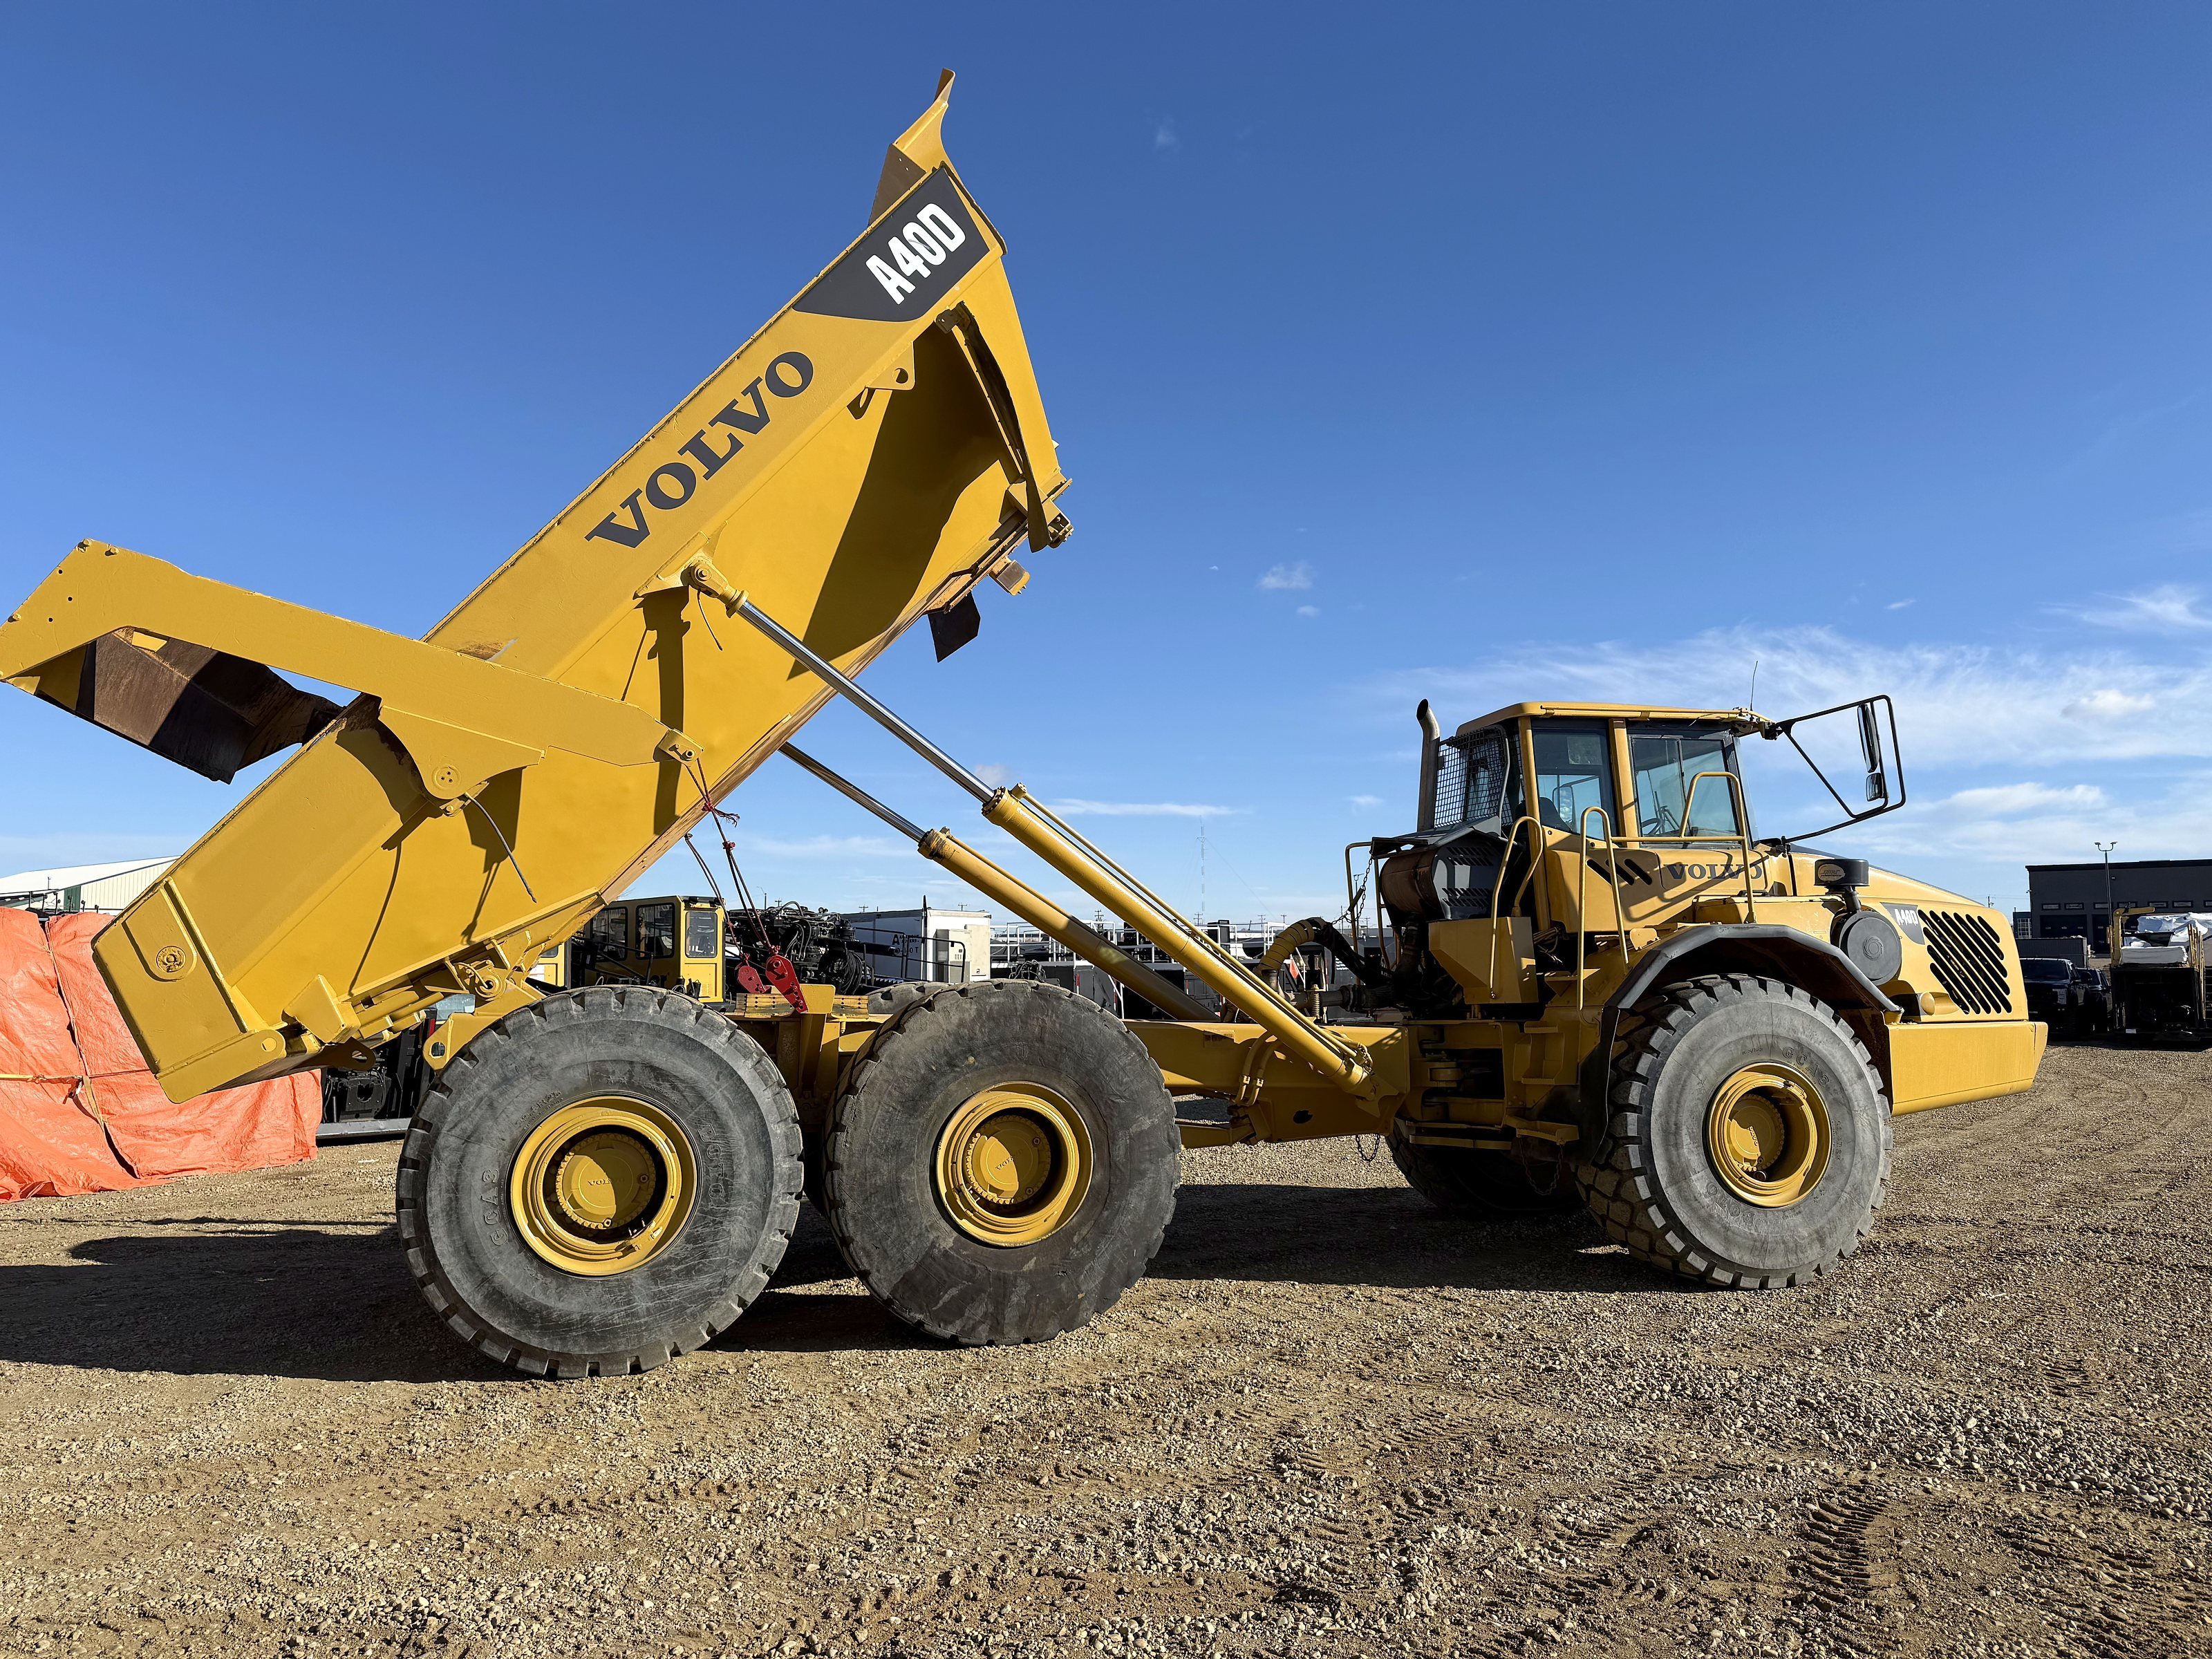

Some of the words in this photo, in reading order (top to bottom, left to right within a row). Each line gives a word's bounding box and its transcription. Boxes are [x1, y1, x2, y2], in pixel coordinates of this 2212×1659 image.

[865, 203, 966, 305] A40D
[584, 351, 814, 548] VOLVO
[1663, 864, 1763, 879] VOLVO
[481, 1168, 509, 1246] GCA3
